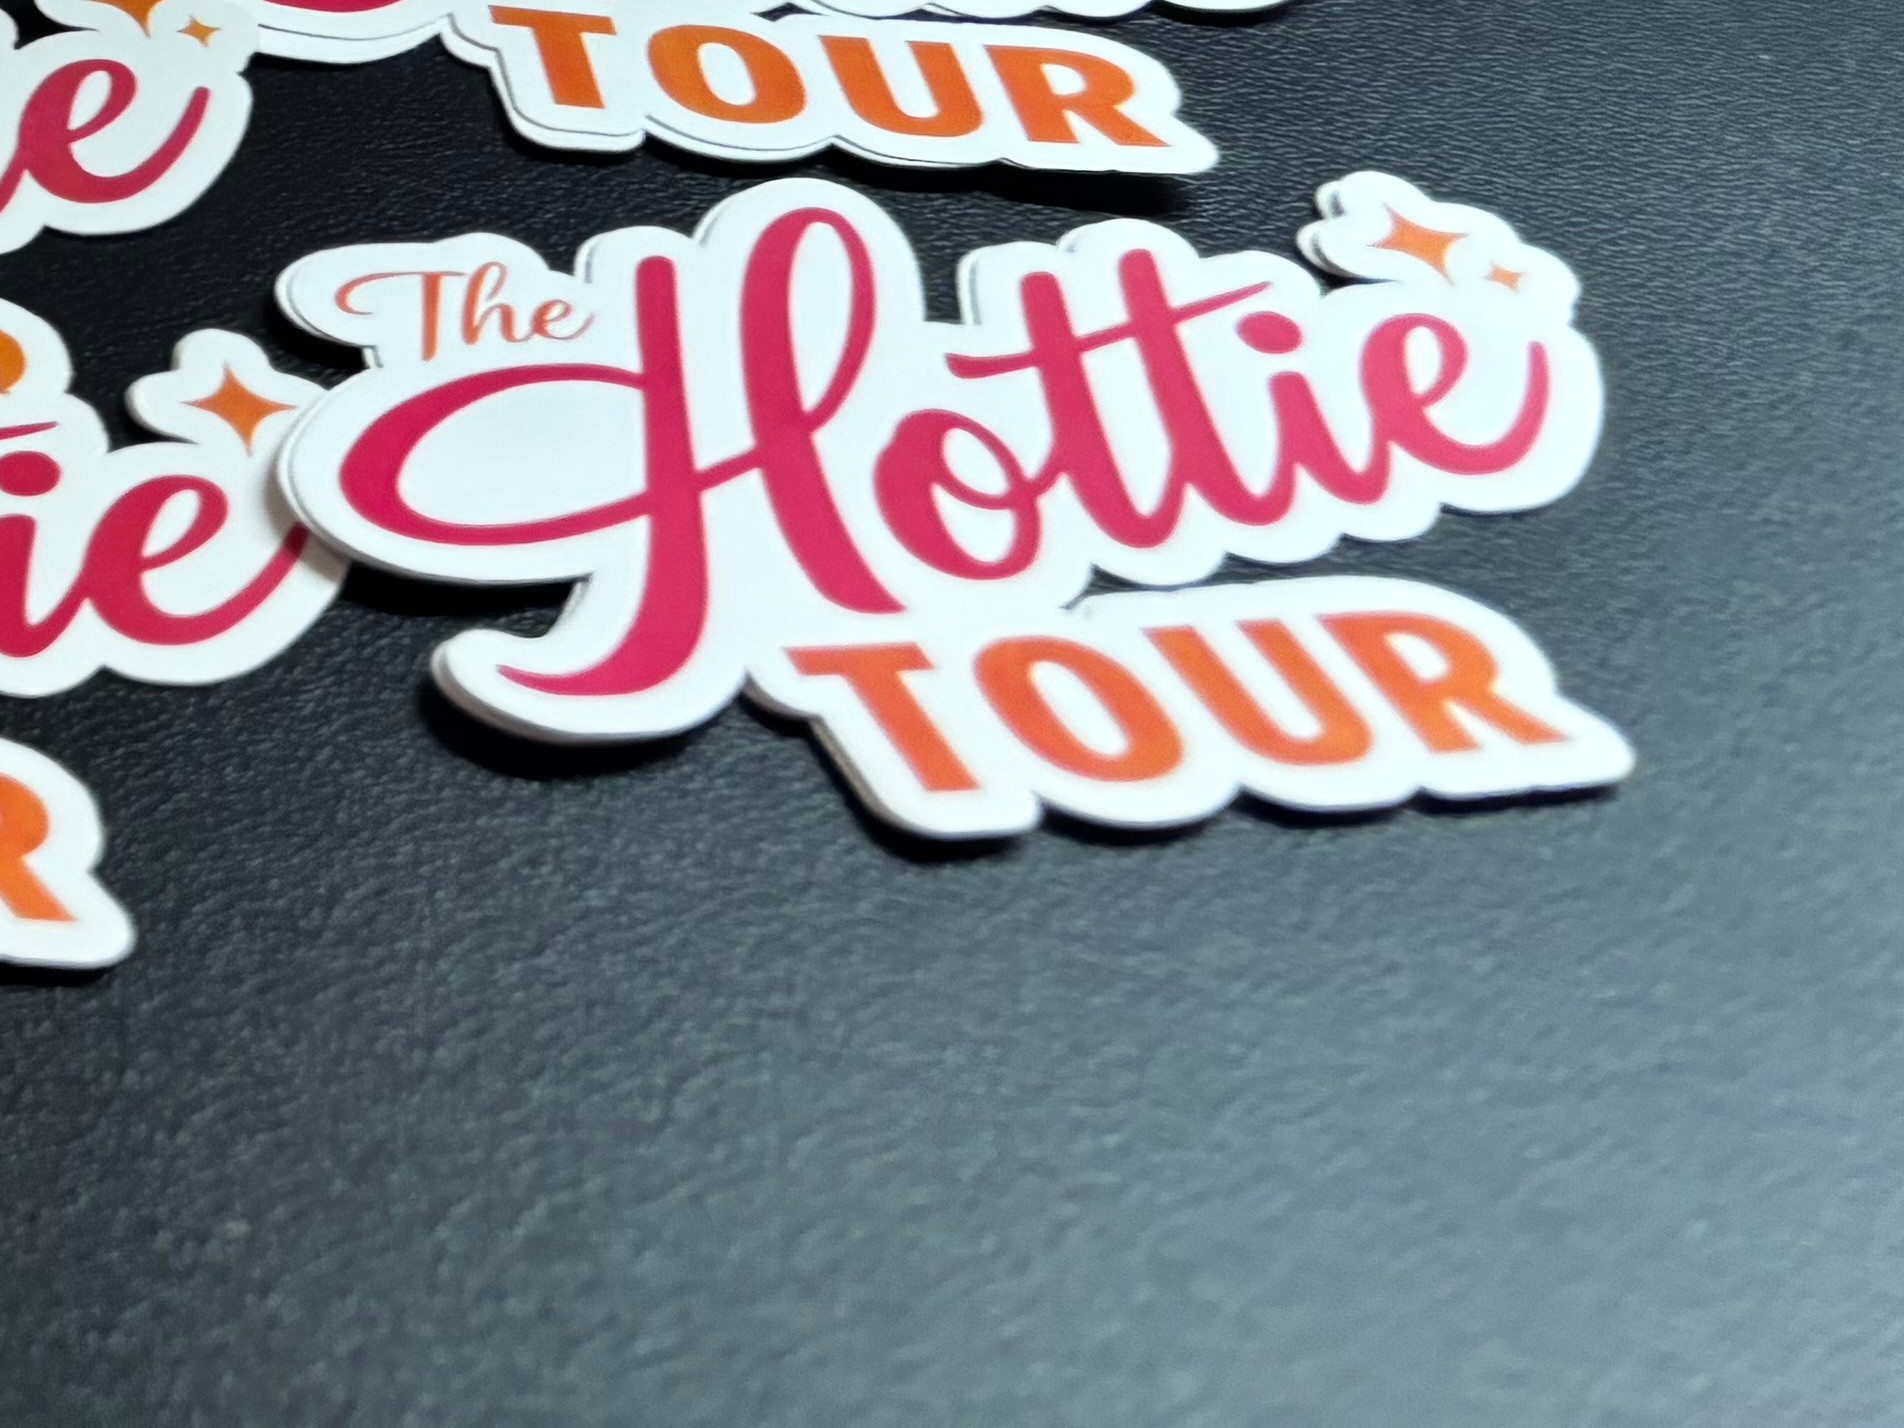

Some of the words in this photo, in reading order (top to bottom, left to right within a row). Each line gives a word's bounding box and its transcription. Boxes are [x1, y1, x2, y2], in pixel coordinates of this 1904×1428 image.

[487, 5, 1174, 149] TOUR
[334, 259, 599, 362] The
[336, 204, 1552, 698] Hottie
[782, 608, 1574, 794] TOUR
